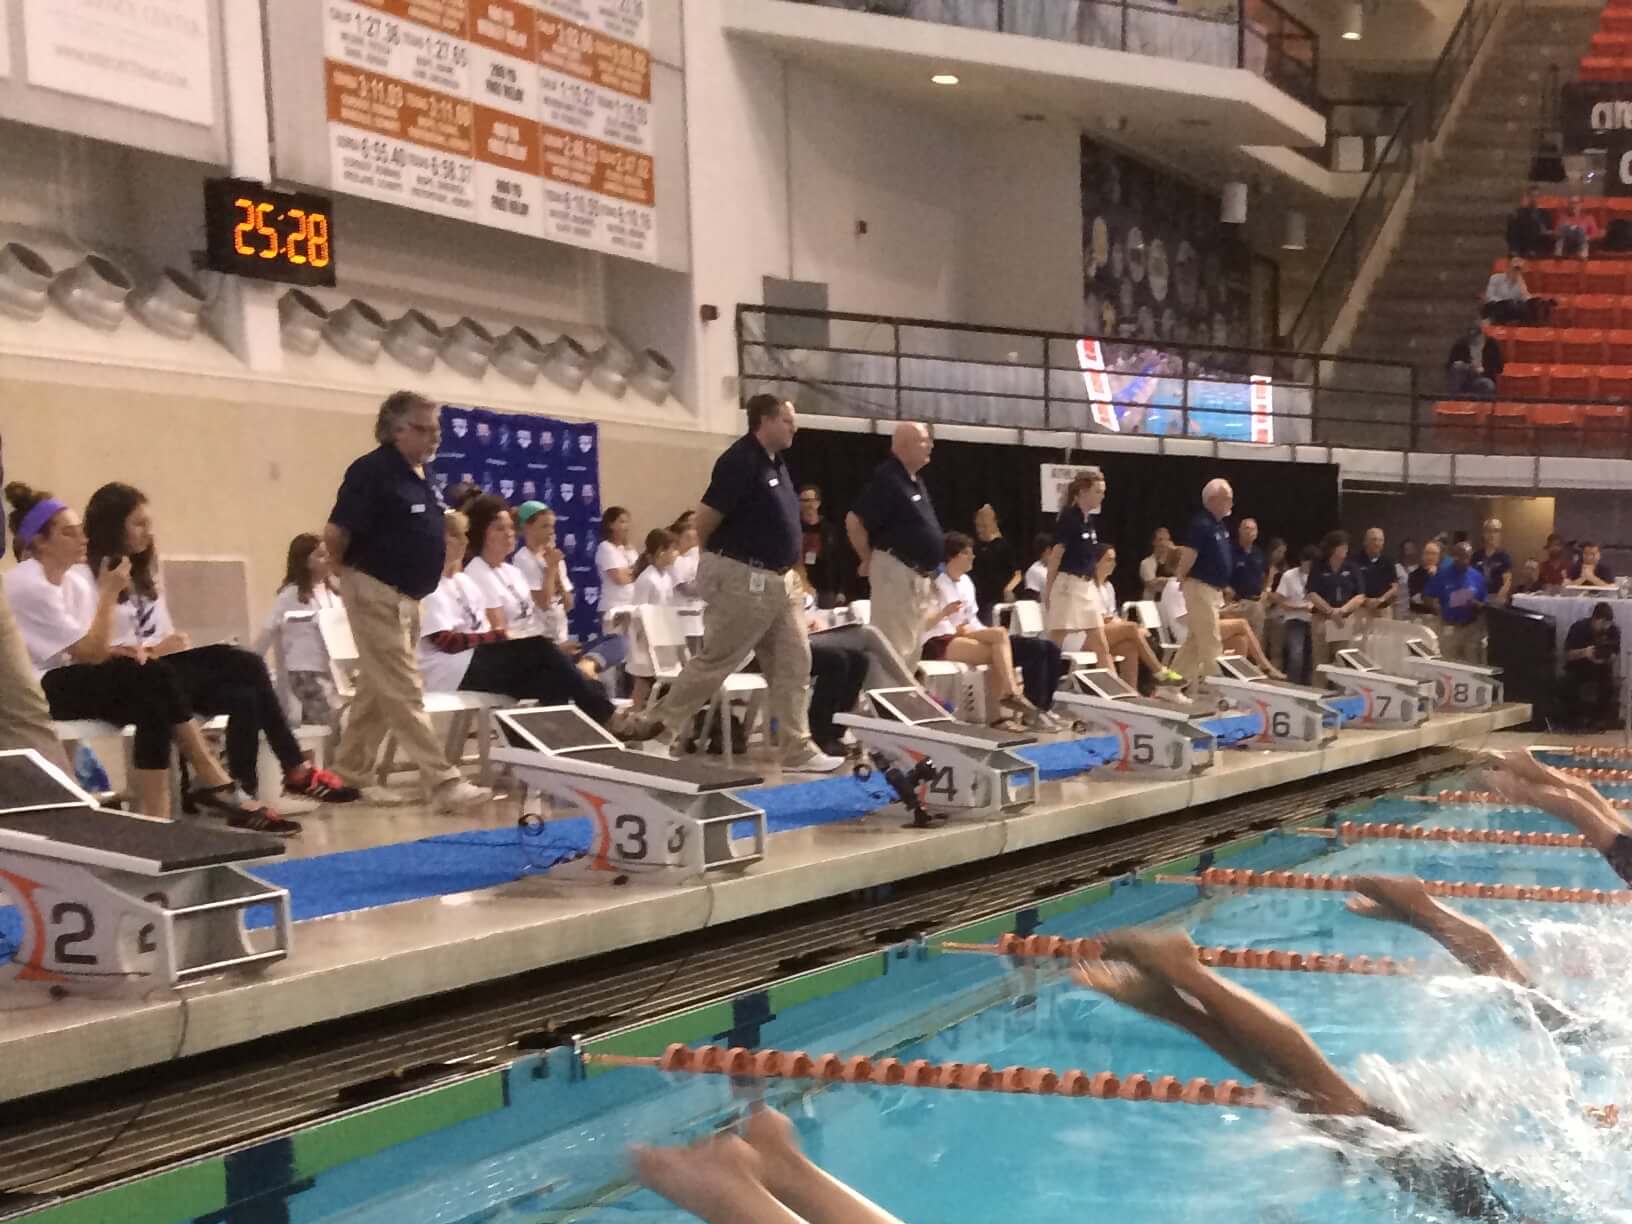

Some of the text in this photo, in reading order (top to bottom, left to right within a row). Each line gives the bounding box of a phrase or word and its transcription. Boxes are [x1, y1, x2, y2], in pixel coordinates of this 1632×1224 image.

[234, 198, 329, 268] 25:28
[1376, 695, 1392, 718] 7
[1454, 683, 1470, 703] 8
[1272, 711, 1291, 738] 6
[1132, 734, 1155, 763] 5
[929, 766, 958, 802] 4
[615, 814, 647, 860] 3
[51, 902, 97, 965] 2
